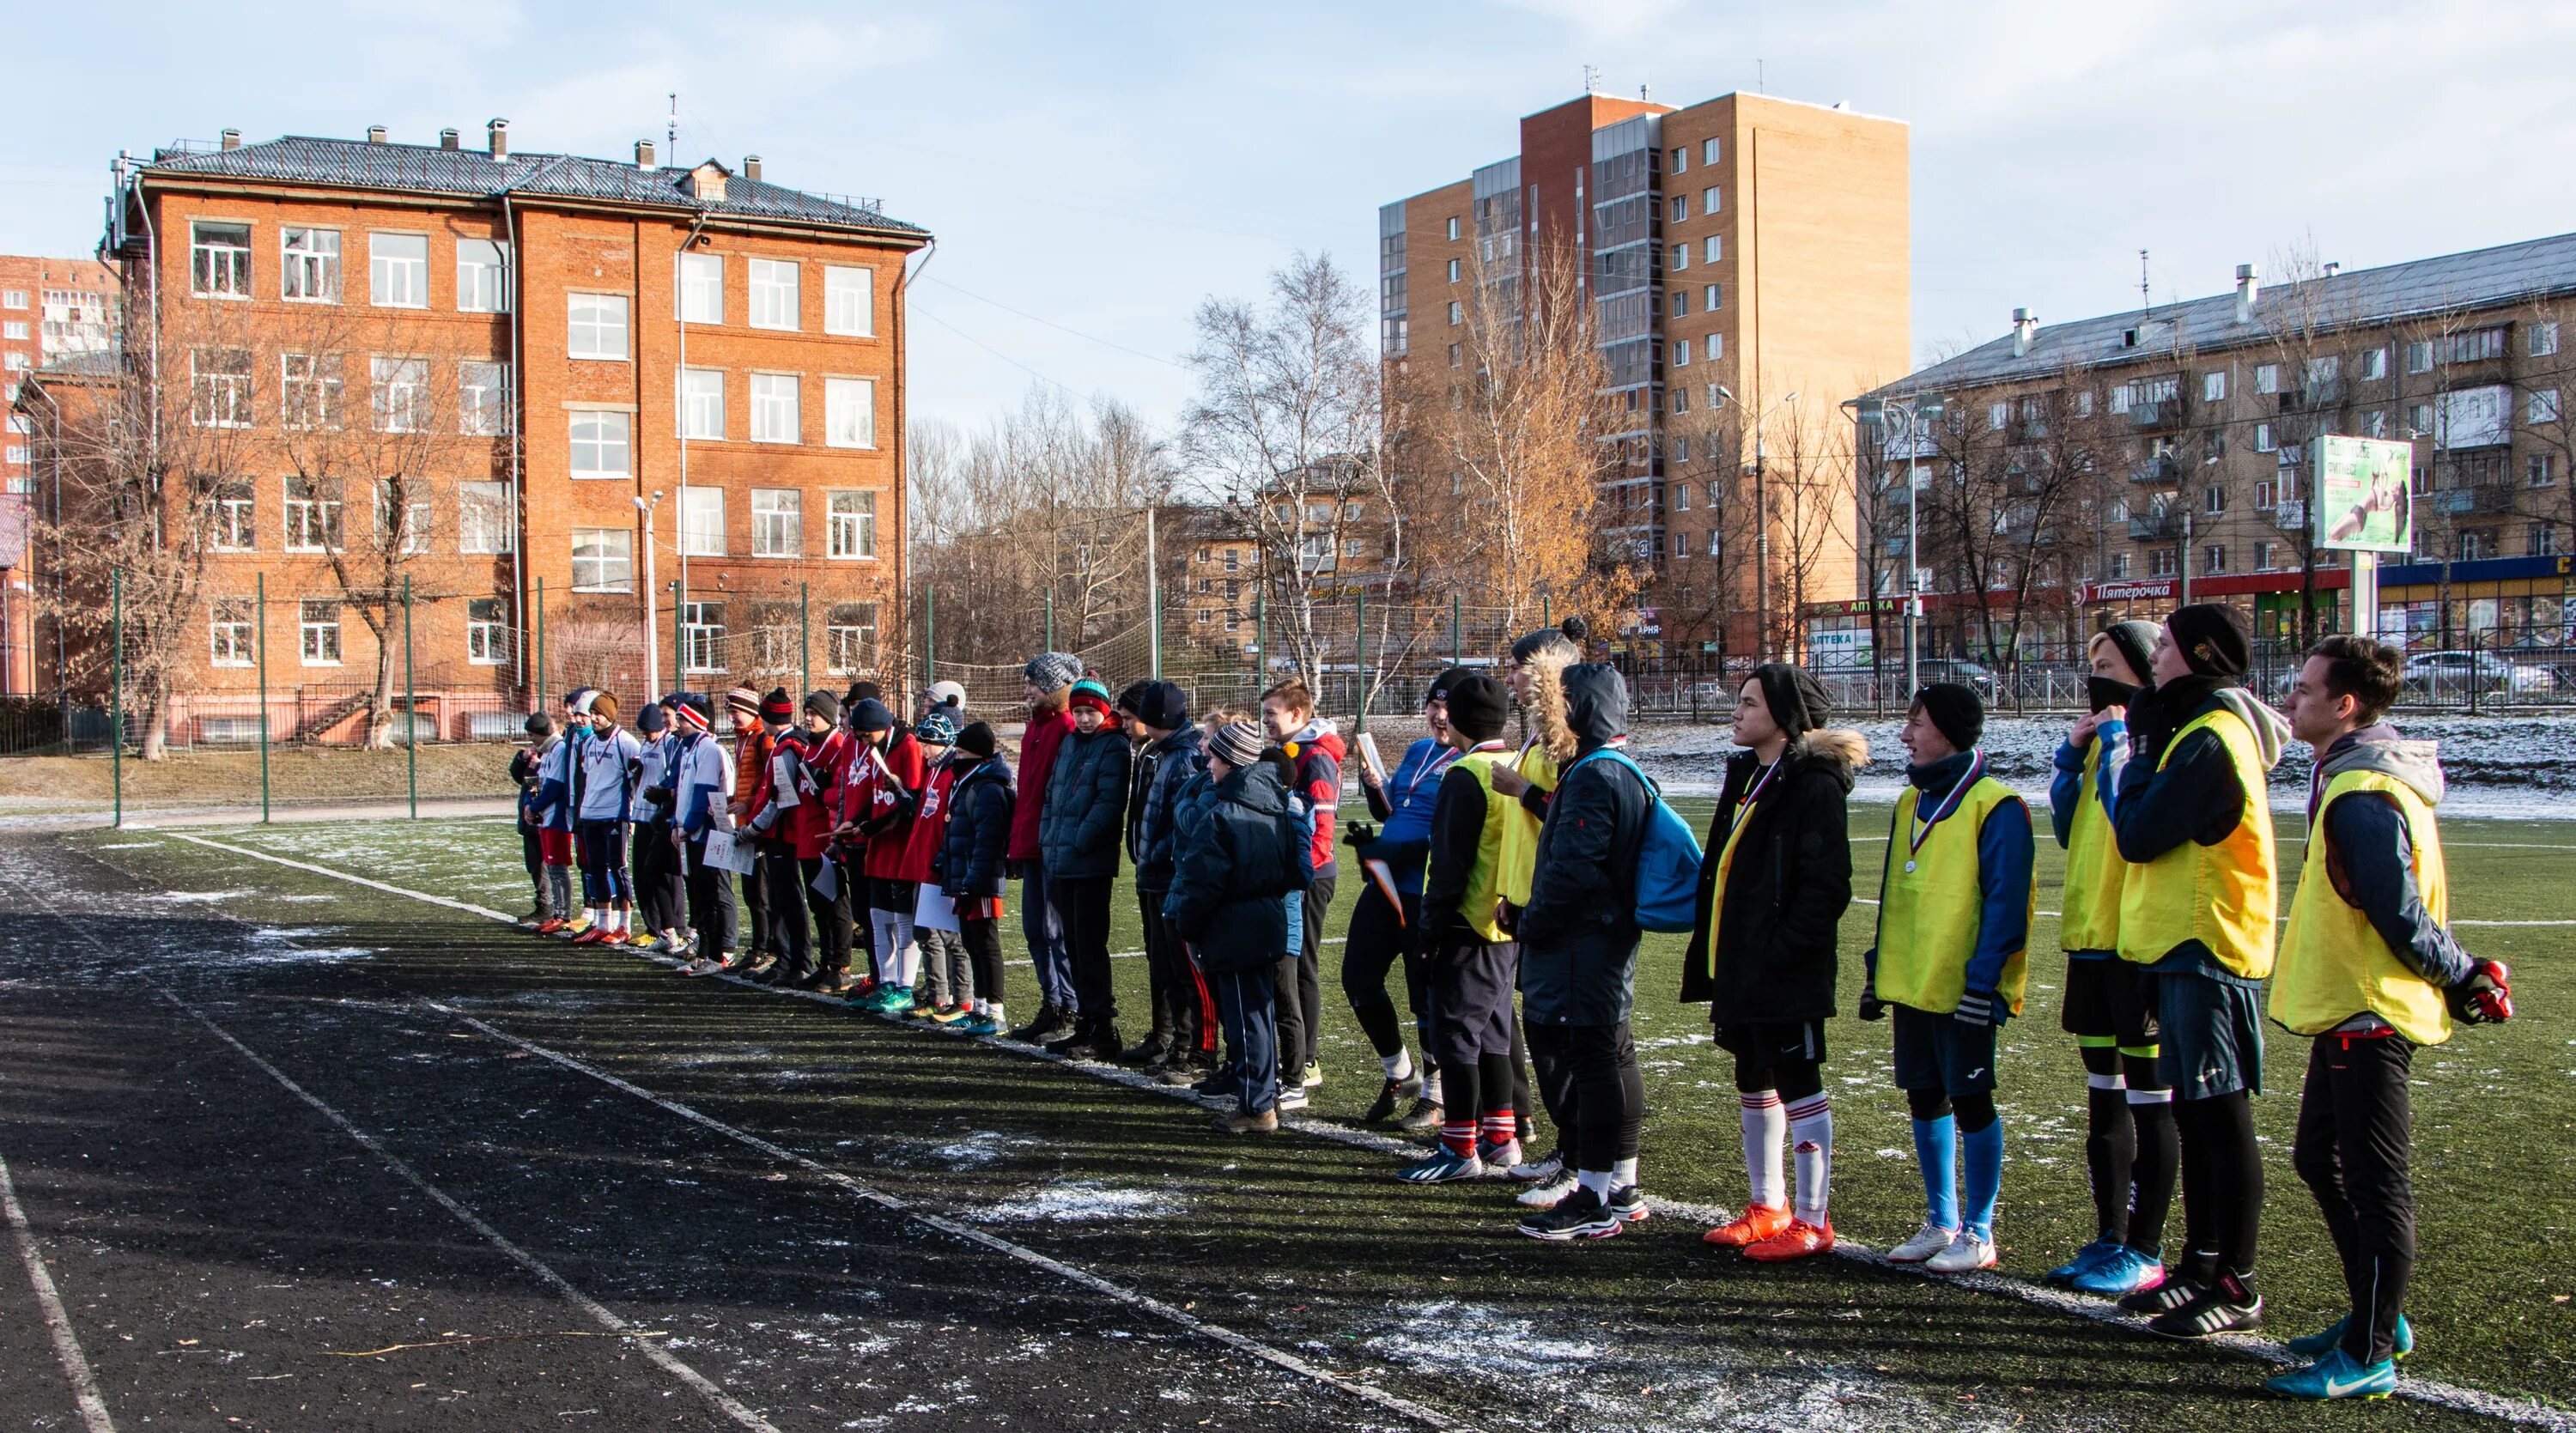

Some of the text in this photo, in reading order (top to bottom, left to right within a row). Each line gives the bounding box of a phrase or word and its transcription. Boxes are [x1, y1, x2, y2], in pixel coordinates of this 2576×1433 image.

[2093, 583, 2171, 602] Пятерочка
[1850, 600, 1894, 612] АПТКА
[1809, 635, 1851, 646] АПТЕКА
